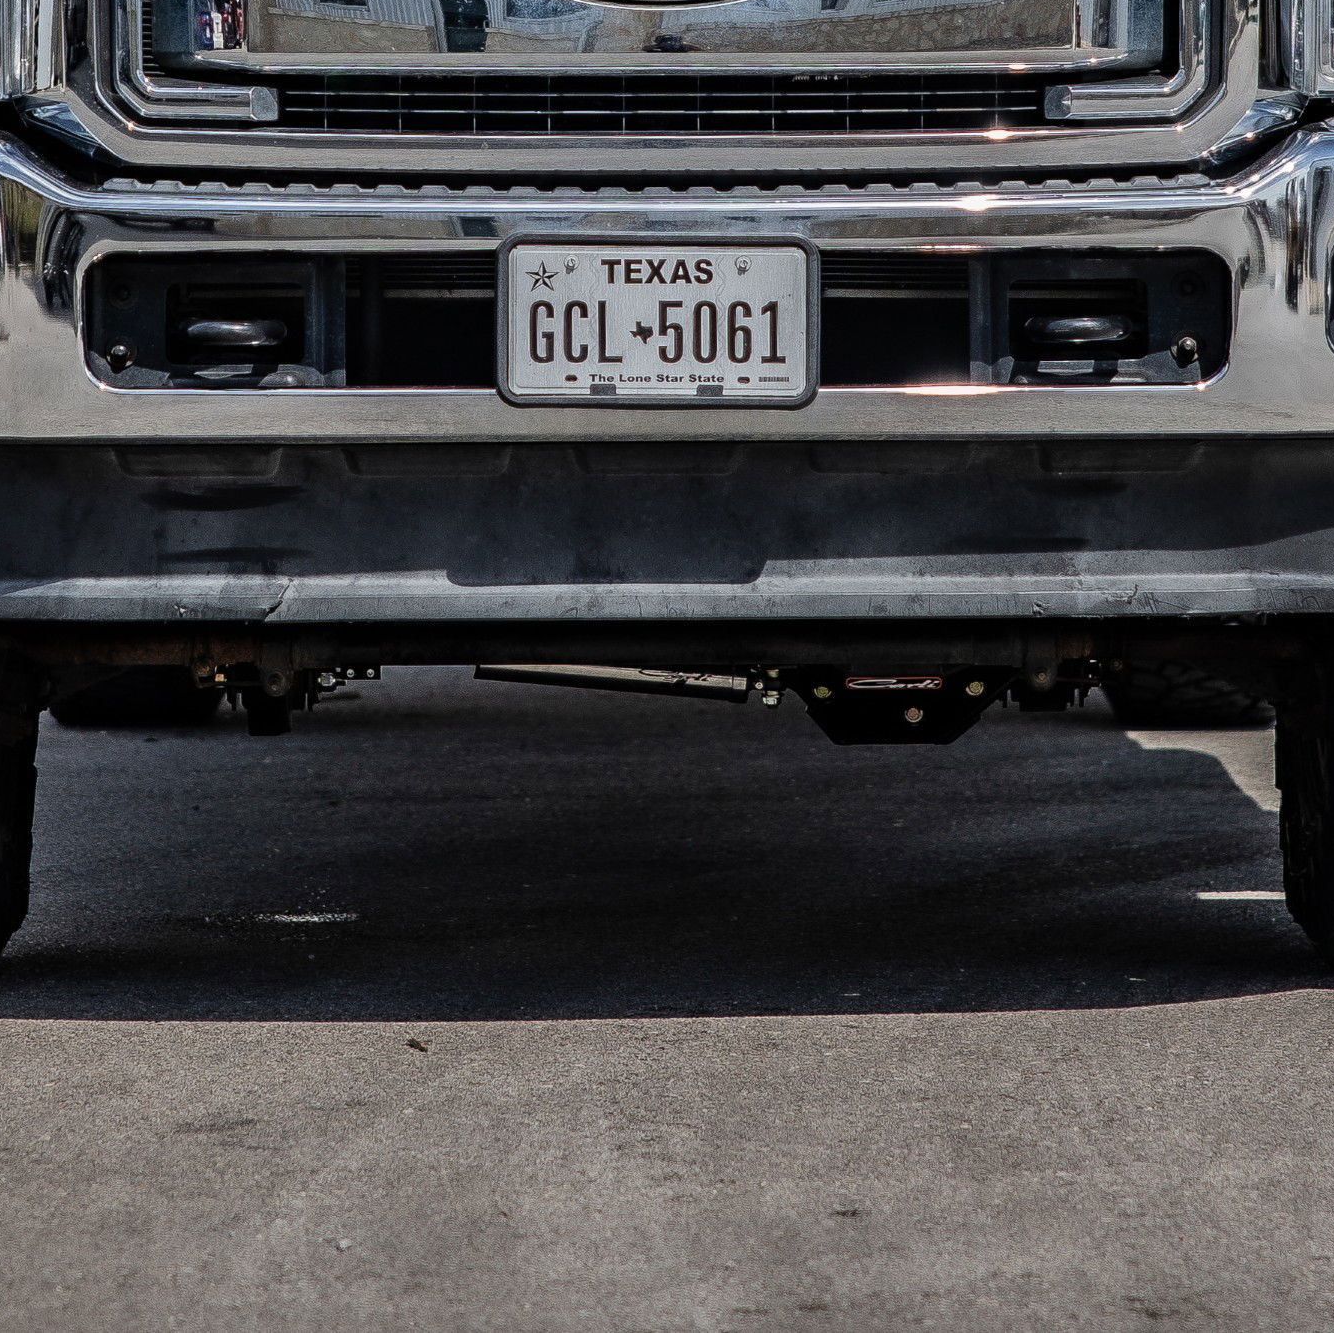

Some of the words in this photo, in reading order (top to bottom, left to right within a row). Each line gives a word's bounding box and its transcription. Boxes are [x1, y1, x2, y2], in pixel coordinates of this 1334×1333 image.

[601, 258, 714, 285] TEXAS
[528, 300, 623, 365] GCL
[658, 300, 787, 365] 5061
[589, 373, 615, 383] The
[619, 373, 651, 383] Lone
[656, 373, 684, 383] Star
[688, 373, 725, 384] State
